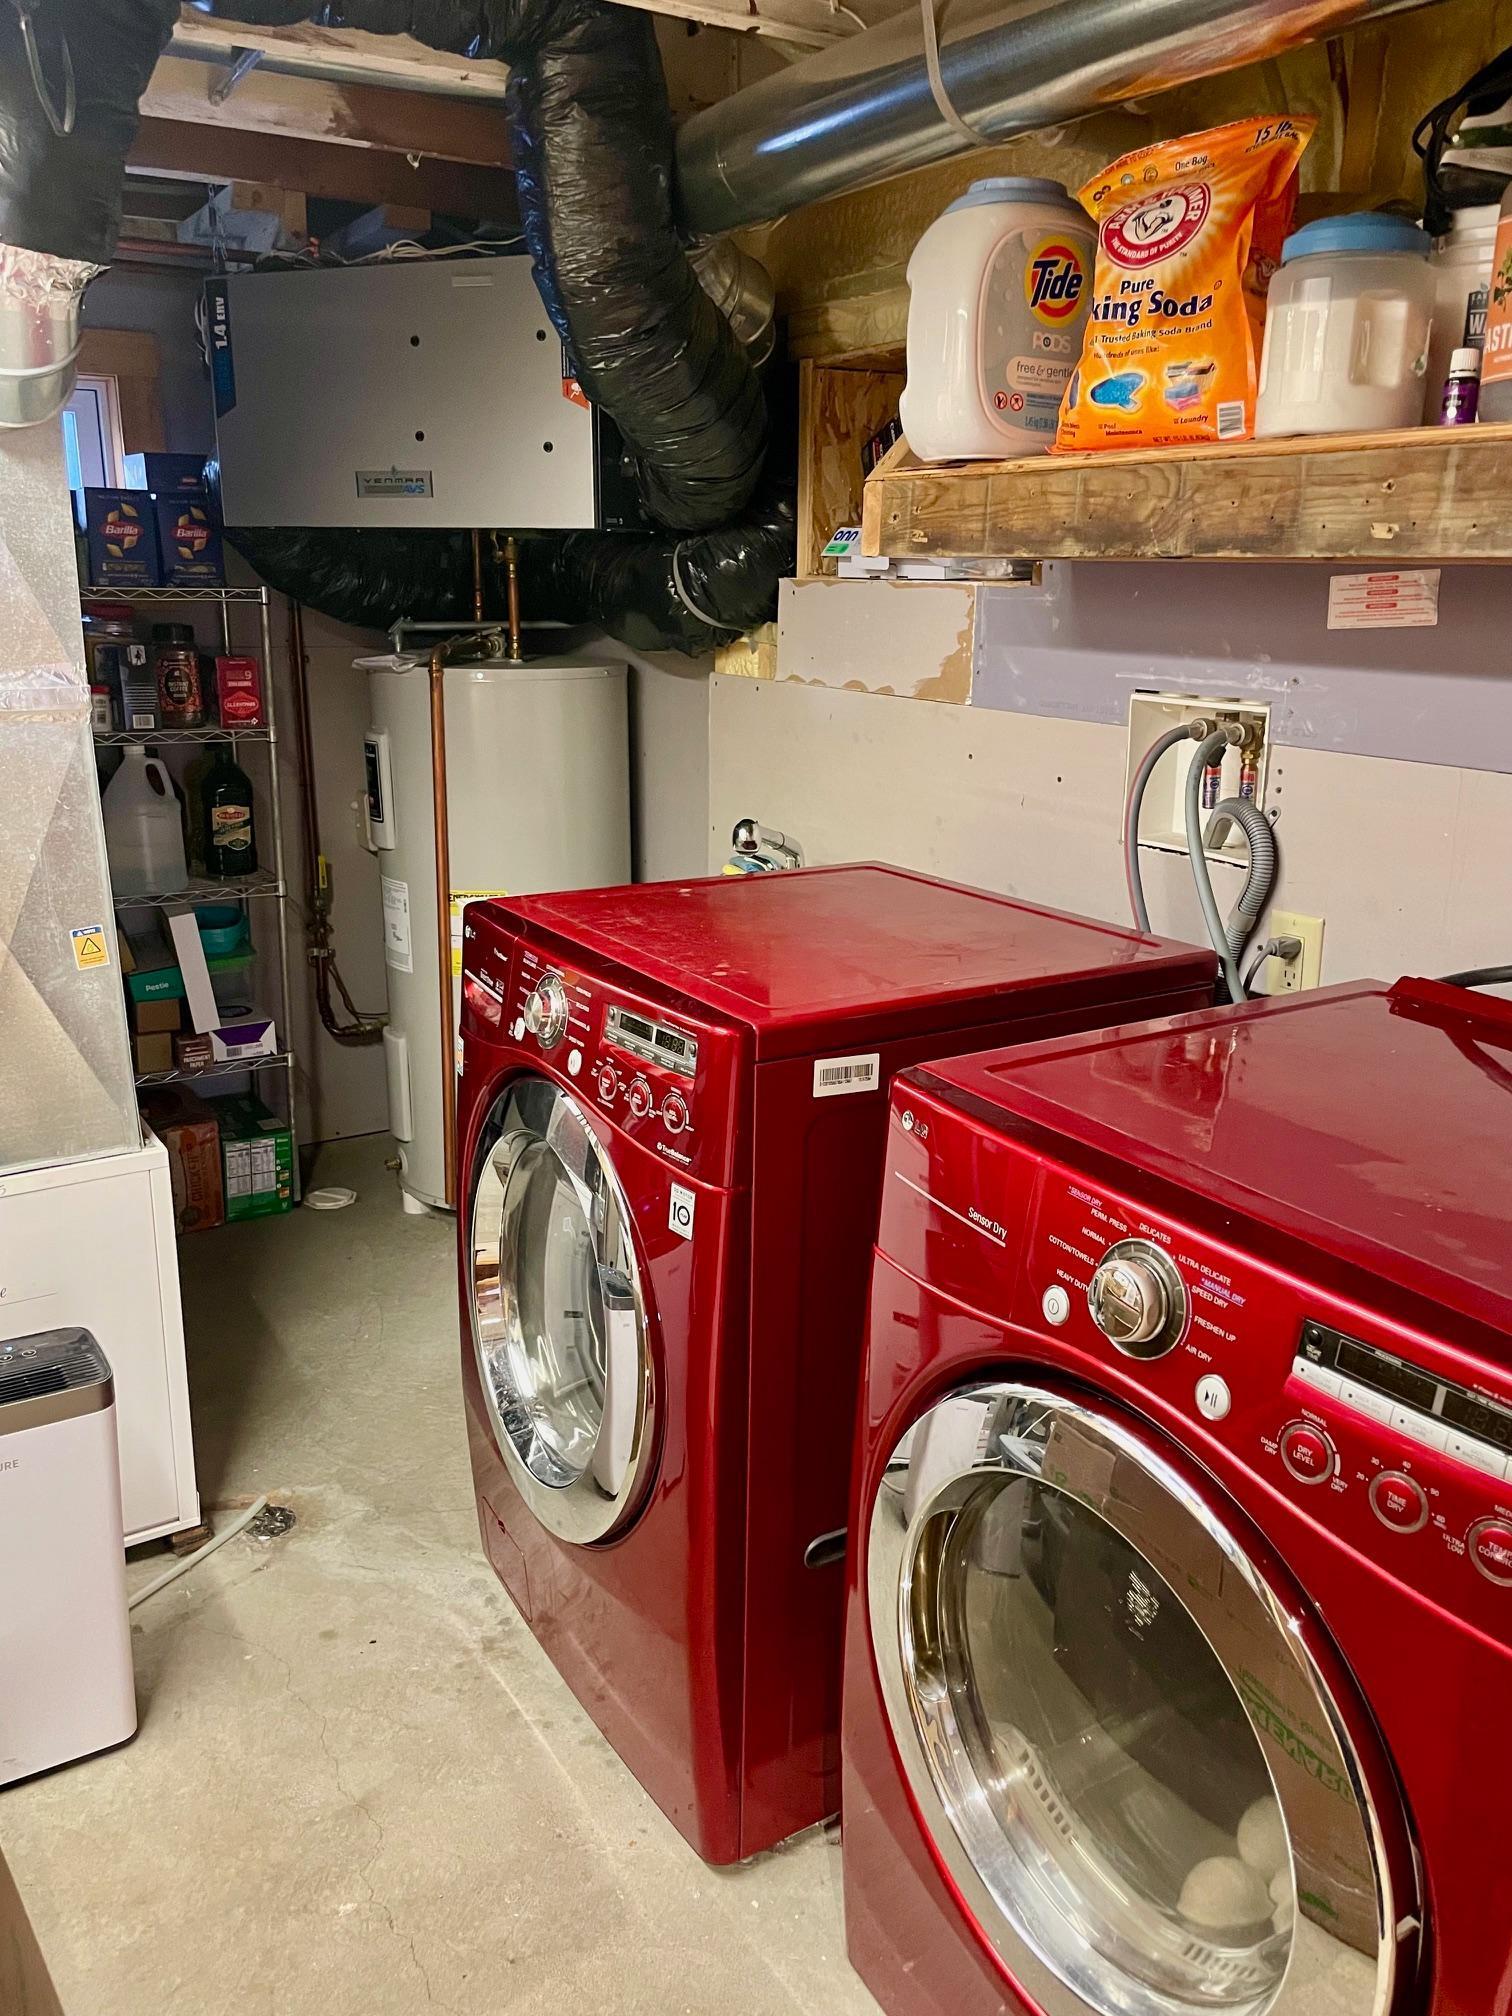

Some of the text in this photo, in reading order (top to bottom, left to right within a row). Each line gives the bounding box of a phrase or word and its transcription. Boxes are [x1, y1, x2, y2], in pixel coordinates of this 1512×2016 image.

[1254, 124, 1273, 145] 15
[1175, 160, 1190, 172] One
[1117, 244, 1150, 259] STANDARD
[1149, 246, 1158, 256] OF
[1159, 231, 1184, 252] PURITY
[1030, 259, 1083, 308] Tide
[1120, 278, 1155, 295] Pure
[1147, 290, 1213, 317] Soda
[213, 323, 228, 351] 1.4
[1101, 333, 1131, 344] Trusted
[1131, 328, 1157, 342] Baking
[1159, 326, 1182, 337] Soda
[1185, 318, 1213, 334] Brand
[1016, 360, 1036, 373] free
[1180, 414, 1209, 424] Laundry
[403, 484, 425, 494] AVS
[105, 524, 139, 535] Barilla
[176, 528, 208, 538] Barilla
[145, 981, 170, 992] Pestie
[183, 1053, 211, 1063] PARCHMENT
[1091, 1197, 1103, 1207] DRY
[673, 1201, 690, 1226] 10
[1090, 1207, 1128, 1233] PERM. PRESS
[968, 1206, 1008, 1240] Sensor Dry
[1081, 1226, 1106, 1246] NORMAL
[1138, 1222, 1172, 1245] DELICATES
[1048, 1234, 1095, 1266] COTTON/TOWELS
[1178, 1254, 1232, 1287] ULTRA DELICATE
[1056, 1268, 1091, 1294] HEAVY DUTY
[1191, 1285, 1229, 1309] SPEED DRY
[1231, 1293, 1247, 1305] DRY
[1193, 1315, 1237, 1342] FRESHEN UP
[1185, 1343, 1213, 1363] AIR DRY
[1301, 1407, 1328, 1428] NORMAL
[1260, 1436, 1279, 1449] DAMP
[1264, 1444, 1278, 1456] DRY
[1297, 1444, 1314, 1457] DRY
[1292, 1449, 1315, 1467] LEVEL
[1402, 1460, 1412, 1470] 40
[1332, 1476, 1349, 1489] VERY
[1356, 1471, 1365, 1481] 20
[1330, 1483, 1345, 1494] DRY
[1430, 1487, 1440, 1497] 50
[1386, 1499, 1404, 1513] DRY
[1387, 1490, 1407, 1506] TIME
[1442, 1532, 1466, 1549] ULTRA
[1447, 1542, 1465, 1557] LOW
